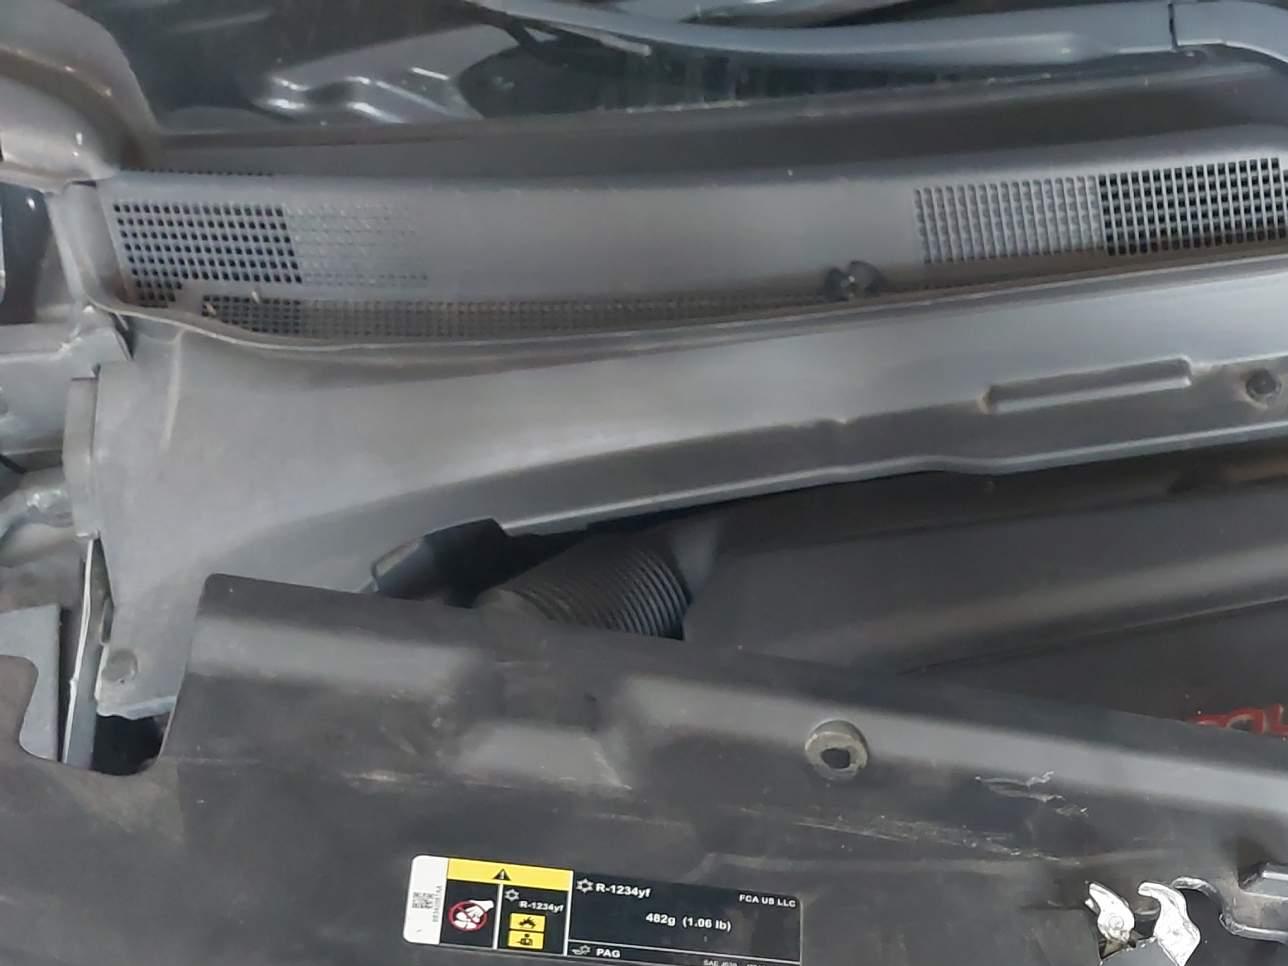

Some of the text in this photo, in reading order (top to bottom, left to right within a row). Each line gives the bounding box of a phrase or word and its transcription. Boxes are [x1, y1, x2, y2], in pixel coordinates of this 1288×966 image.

[595, 882, 651, 898] R-1234yf
[519, 900, 565, 914] R-1234yf
[739, 894, 759, 904] FCA
[777, 899, 796, 908] LLC
[646, 912, 731, 932] 482g (1.06 lb)
[596, 947, 621, 959] PAG
[703, 959, 719, 966] SAE
